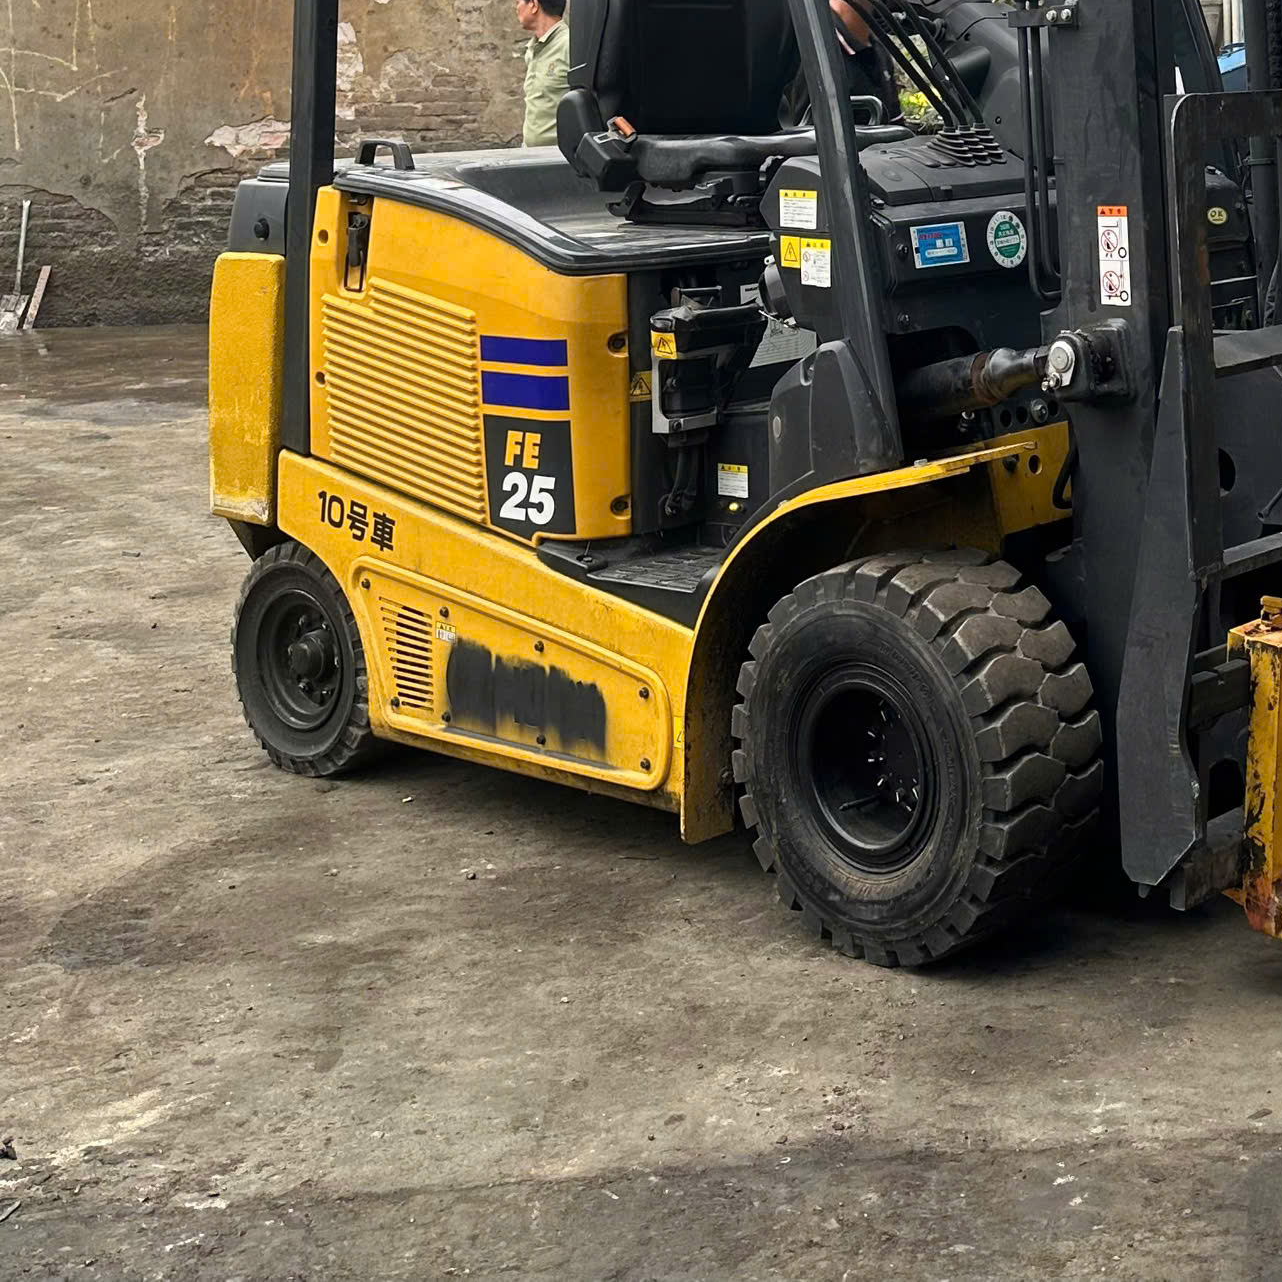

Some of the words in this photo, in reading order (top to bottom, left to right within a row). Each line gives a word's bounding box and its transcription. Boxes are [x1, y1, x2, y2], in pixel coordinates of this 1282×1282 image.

[1210, 209, 1224, 218] OK
[504, 429, 543, 470] FE
[318, 489, 396, 551] 10号車
[499, 471, 556, 526] 25
